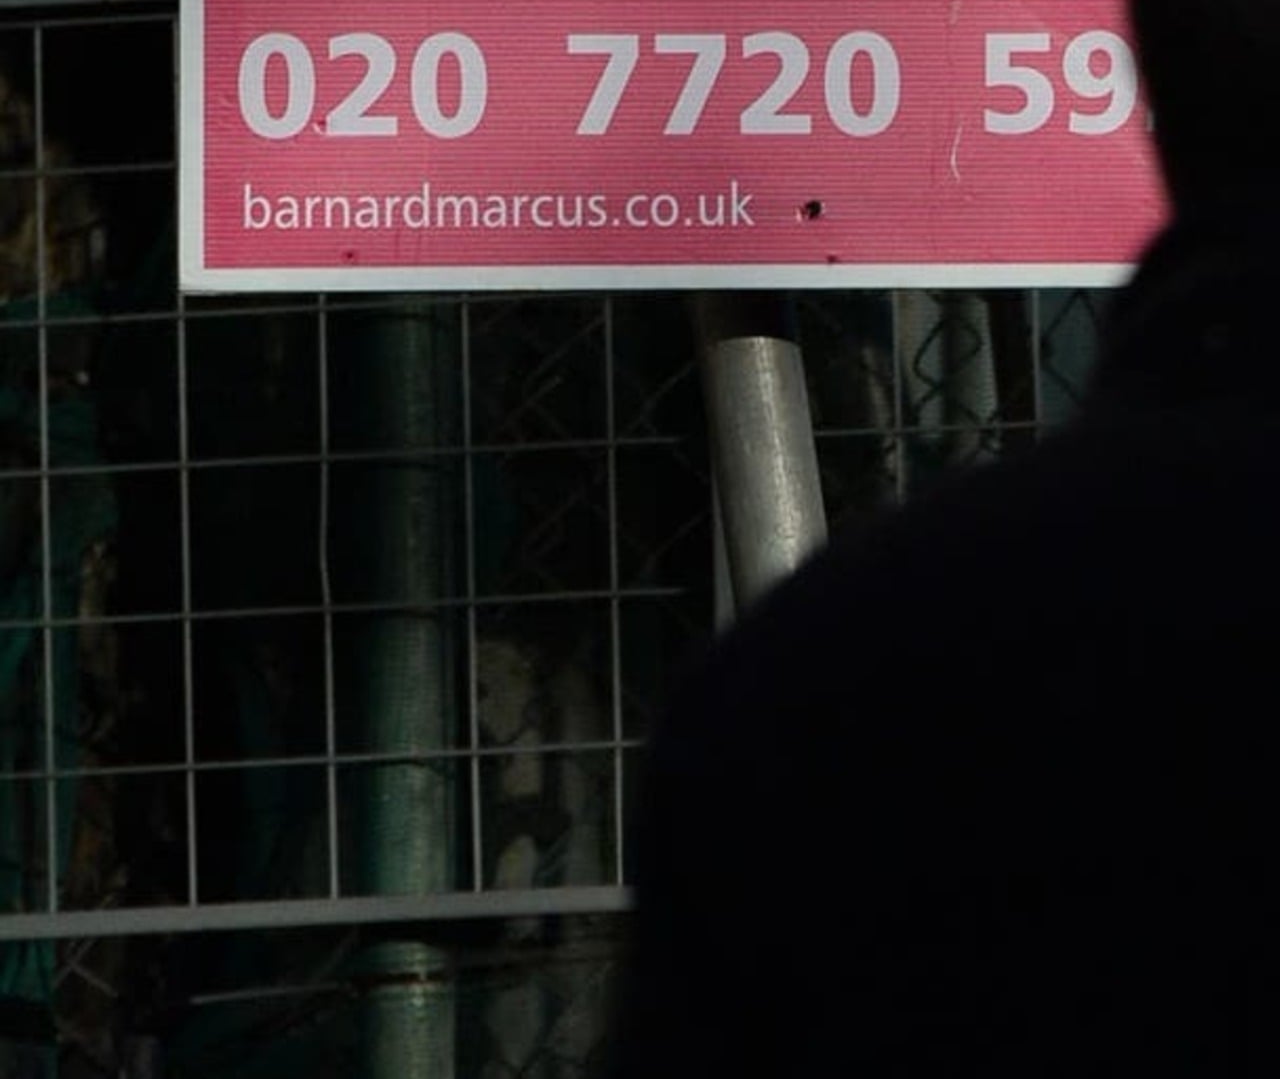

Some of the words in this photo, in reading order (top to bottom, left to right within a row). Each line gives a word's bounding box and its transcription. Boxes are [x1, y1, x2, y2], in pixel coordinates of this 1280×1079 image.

[237, 31, 489, 140] 020
[565, 30, 902, 137] 7720
[982, 29, 1155, 136] 59
[242, 180, 755, 230] barnardmarcus.co.uk
